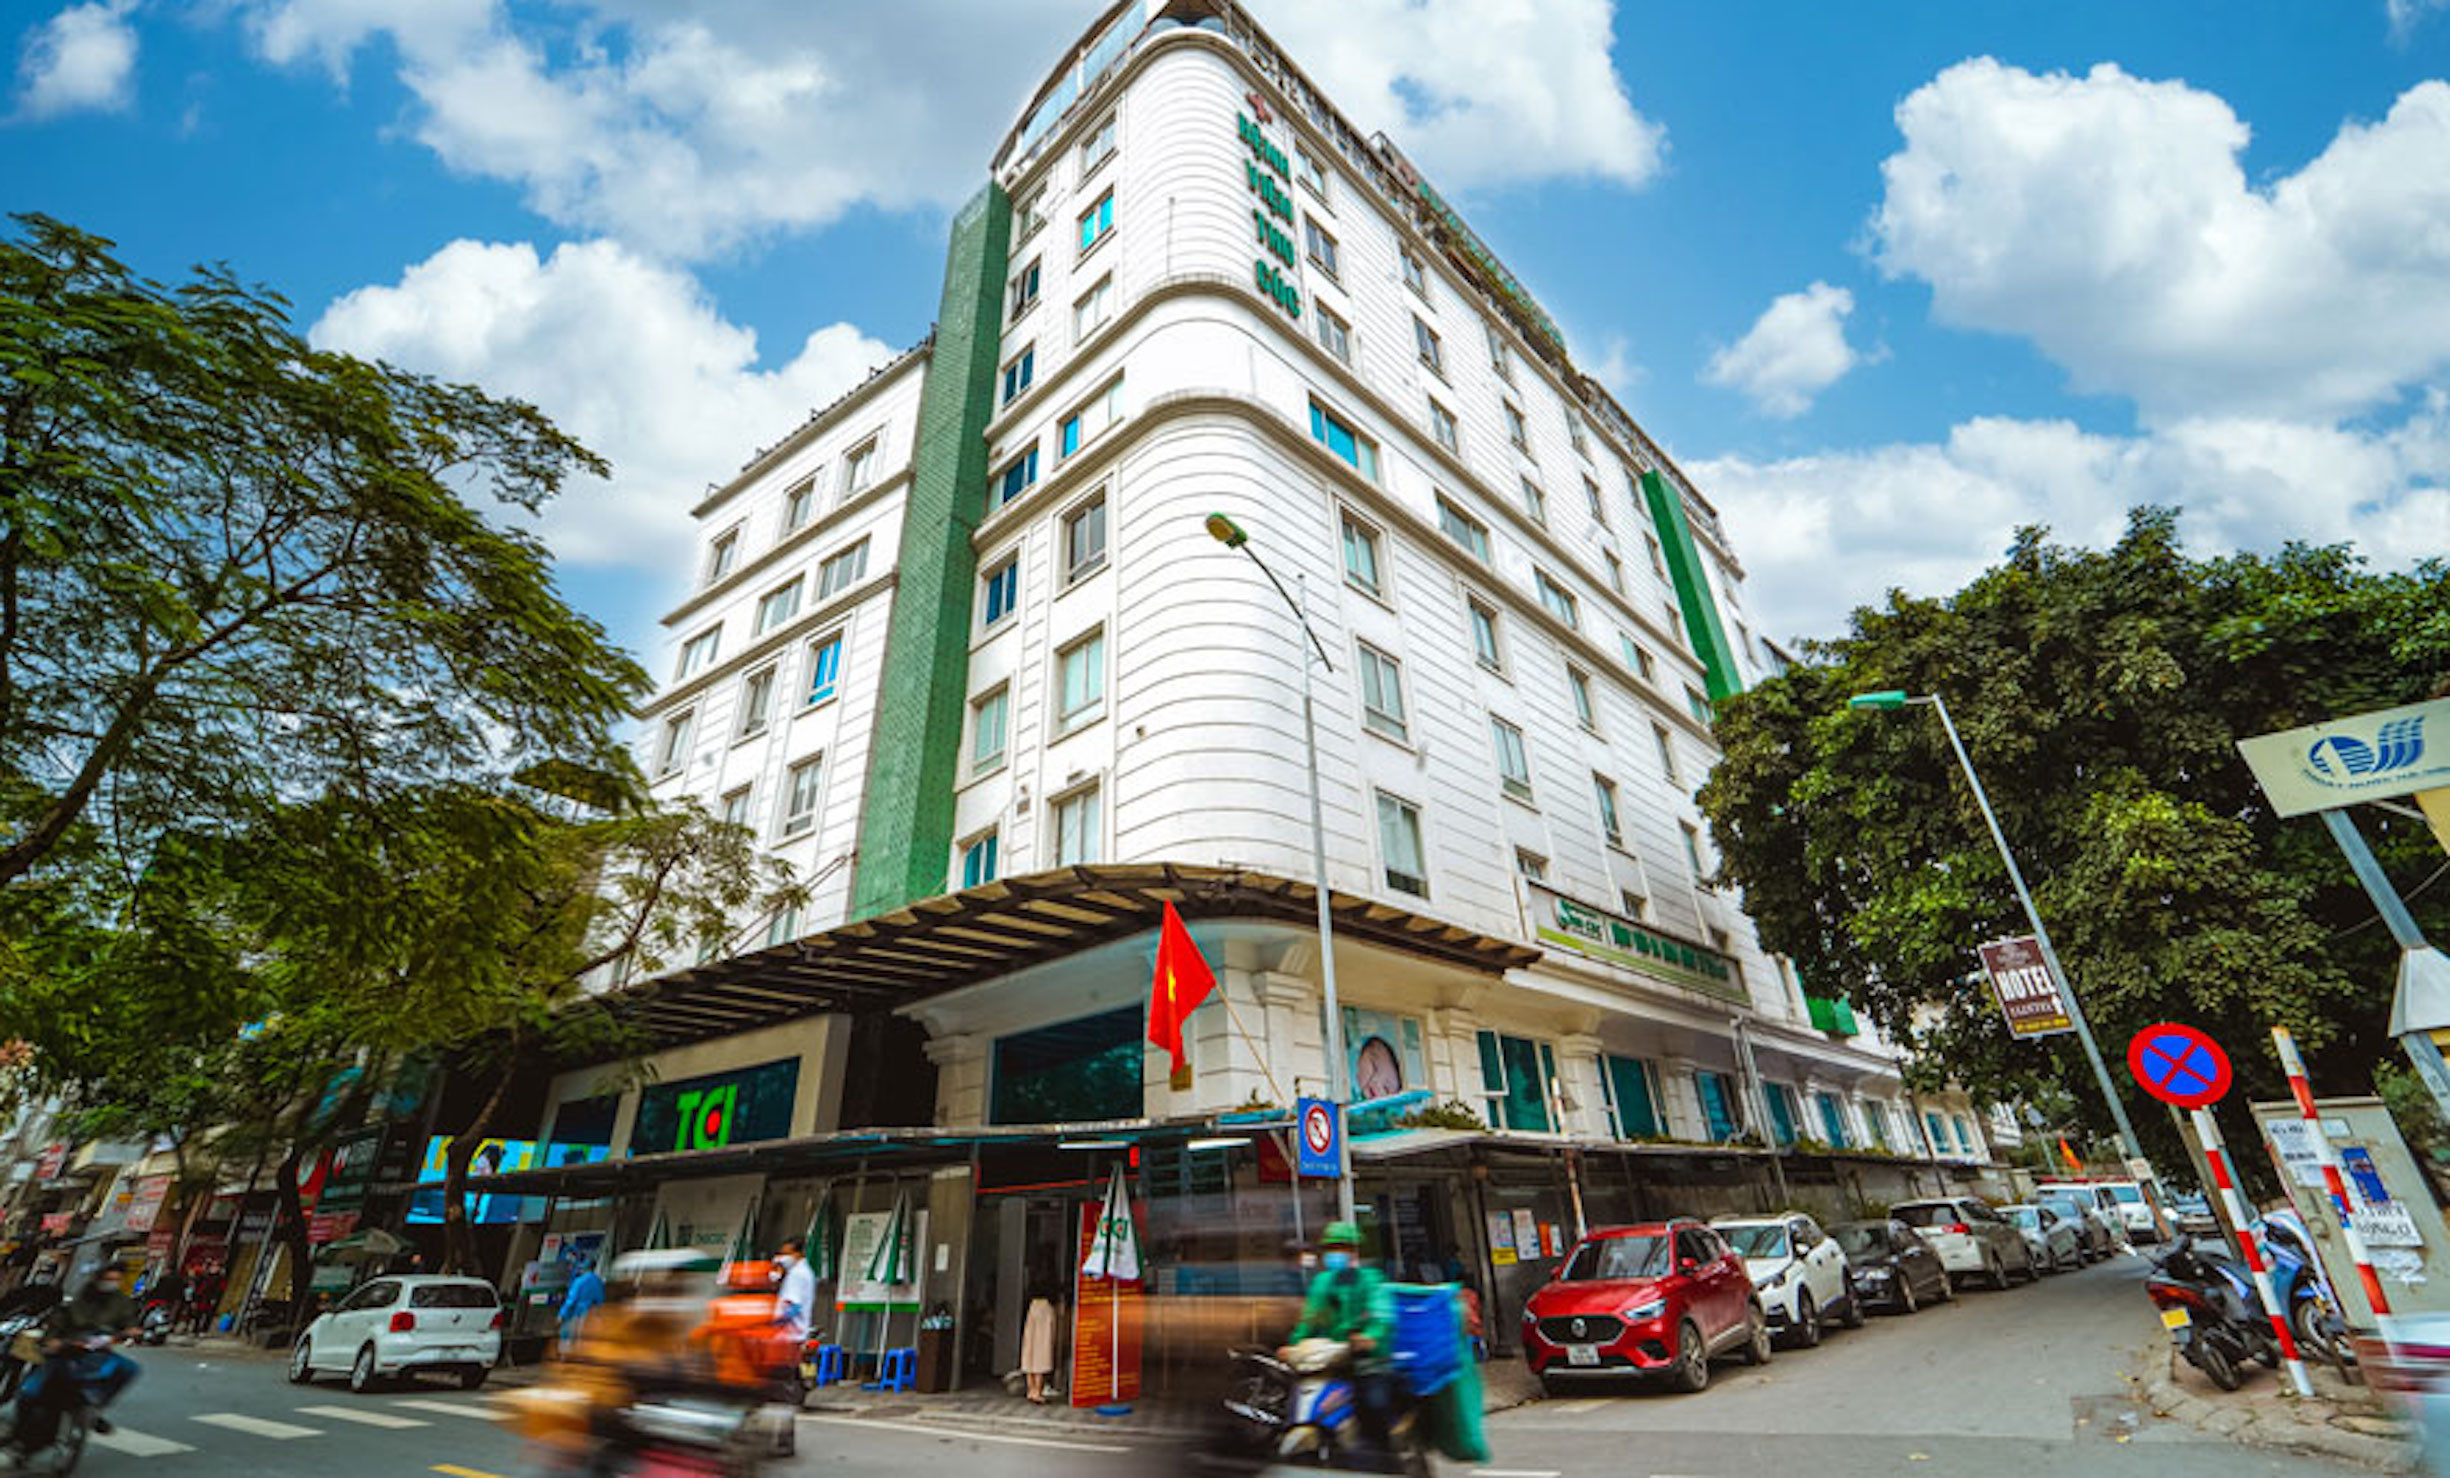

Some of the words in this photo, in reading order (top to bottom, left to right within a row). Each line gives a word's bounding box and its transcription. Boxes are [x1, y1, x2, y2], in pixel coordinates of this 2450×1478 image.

[1252, 208, 1295, 269] THU
[1254, 258, 1301, 319] CÚC
[1994, 965, 2057, 1002] HOTEL
[674, 1083, 738, 1151] TCI
